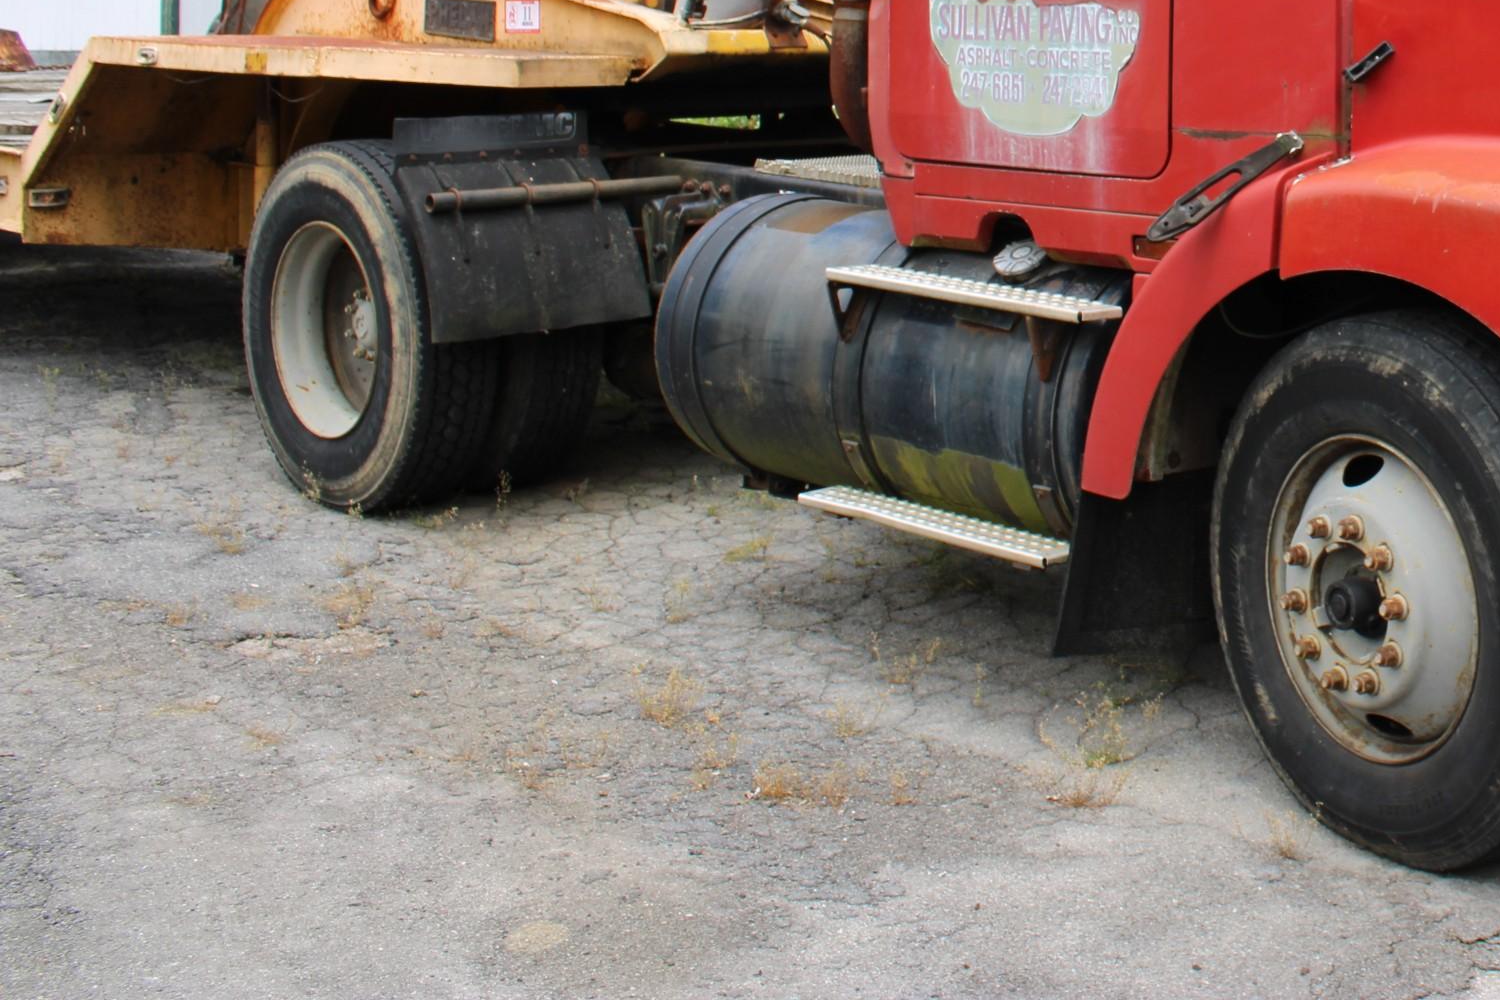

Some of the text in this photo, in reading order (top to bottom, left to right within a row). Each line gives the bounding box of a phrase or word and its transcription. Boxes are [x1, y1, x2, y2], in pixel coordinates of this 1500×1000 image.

[938, 4, 1030, 41] SULLIVAN
[1039, 5, 1113, 44] PAVING
[956, 46, 1112, 71] ASPHALT CONCRETE
[961, 70, 1025, 103] 247-6851
